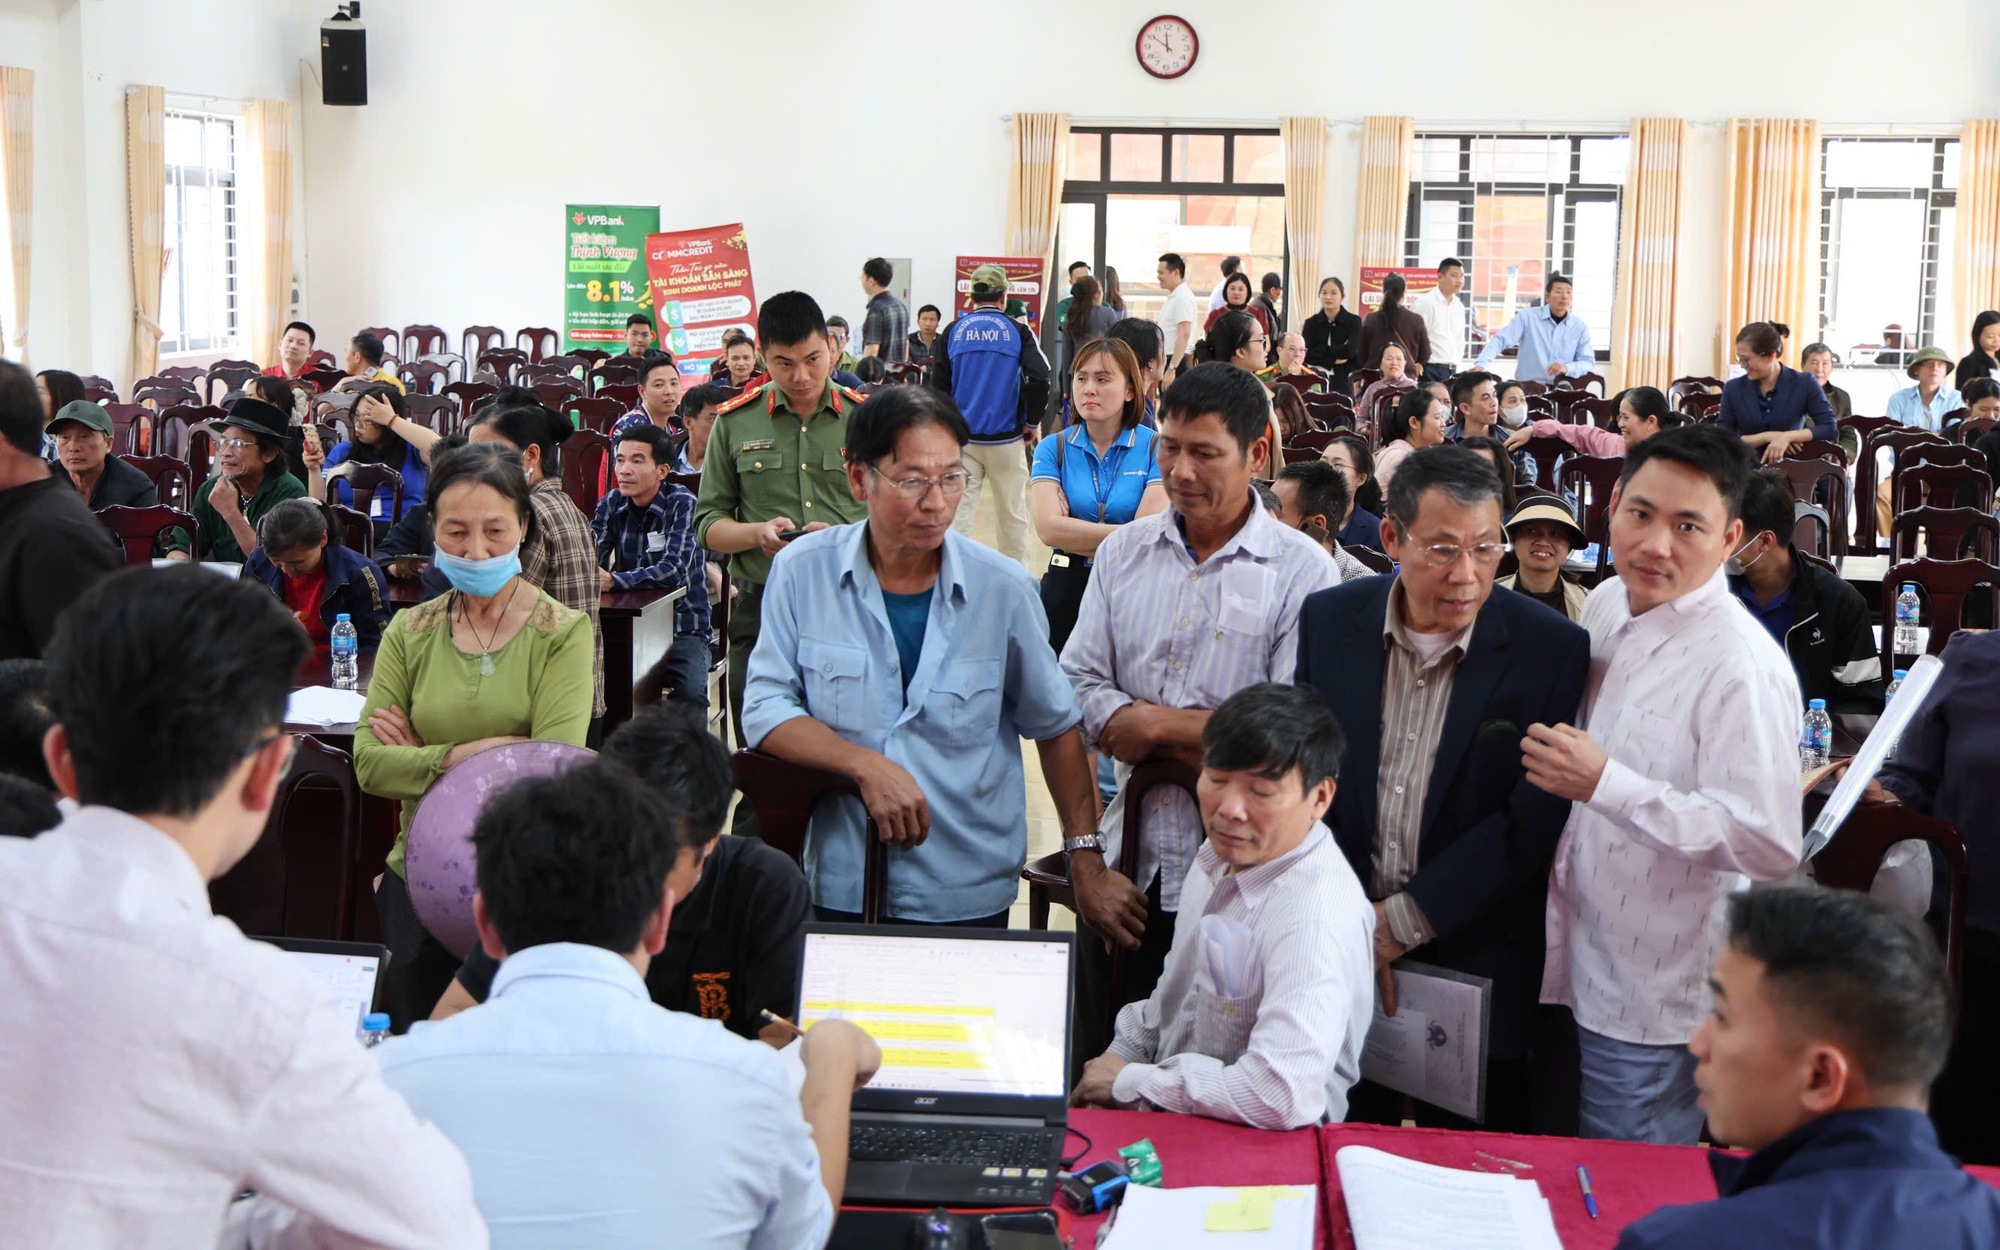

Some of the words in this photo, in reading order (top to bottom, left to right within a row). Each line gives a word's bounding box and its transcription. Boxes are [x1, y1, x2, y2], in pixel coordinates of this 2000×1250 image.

[587, 215, 624, 225] VPBank
[572, 245, 601, 260] Thịnh
[652, 278, 668, 288] TÀI
[723, 268, 748, 278] SÀNG
[662, 288, 680, 296] KINH
[681, 284, 707, 294] DOANH
[724, 279, 742, 288] PHÁT
[966, 327, 980, 340] HÀ
[981, 328, 999, 342] NỘI
